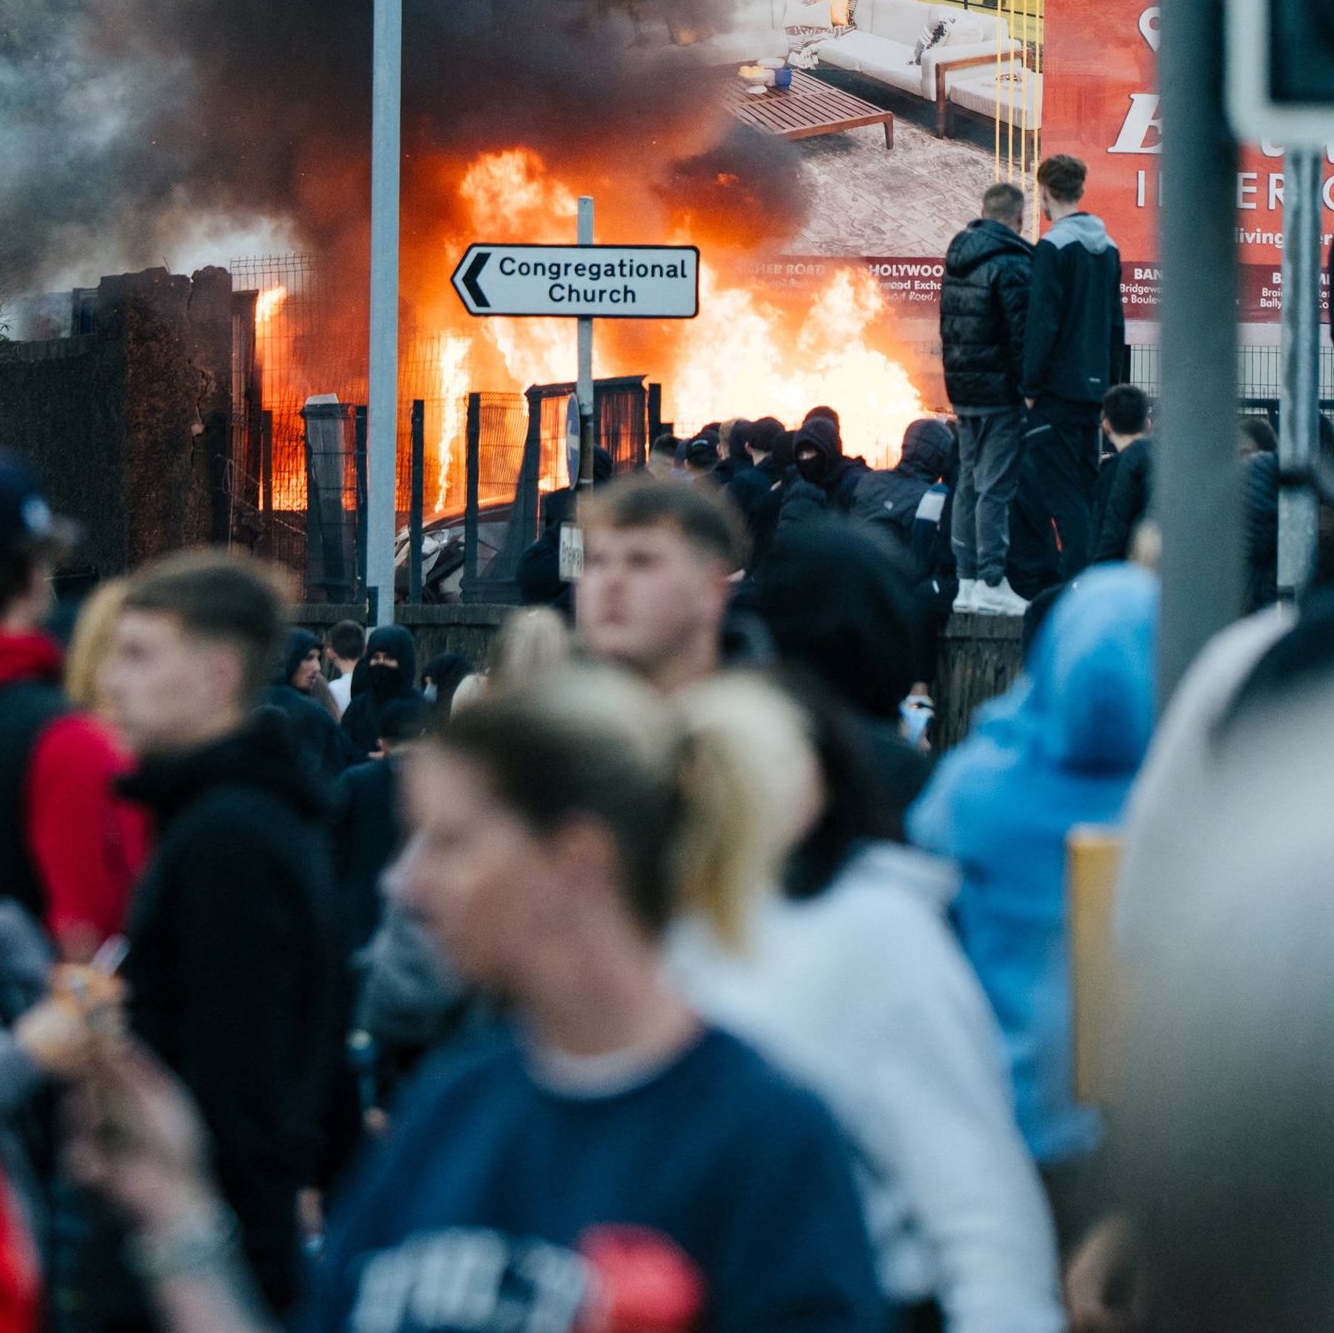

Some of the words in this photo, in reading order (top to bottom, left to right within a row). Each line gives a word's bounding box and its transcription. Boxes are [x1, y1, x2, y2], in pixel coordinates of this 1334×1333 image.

[499, 256, 688, 281] Congregational
[869, 264, 945, 277] HOLYWOO
[548, 283, 637, 304] Church
